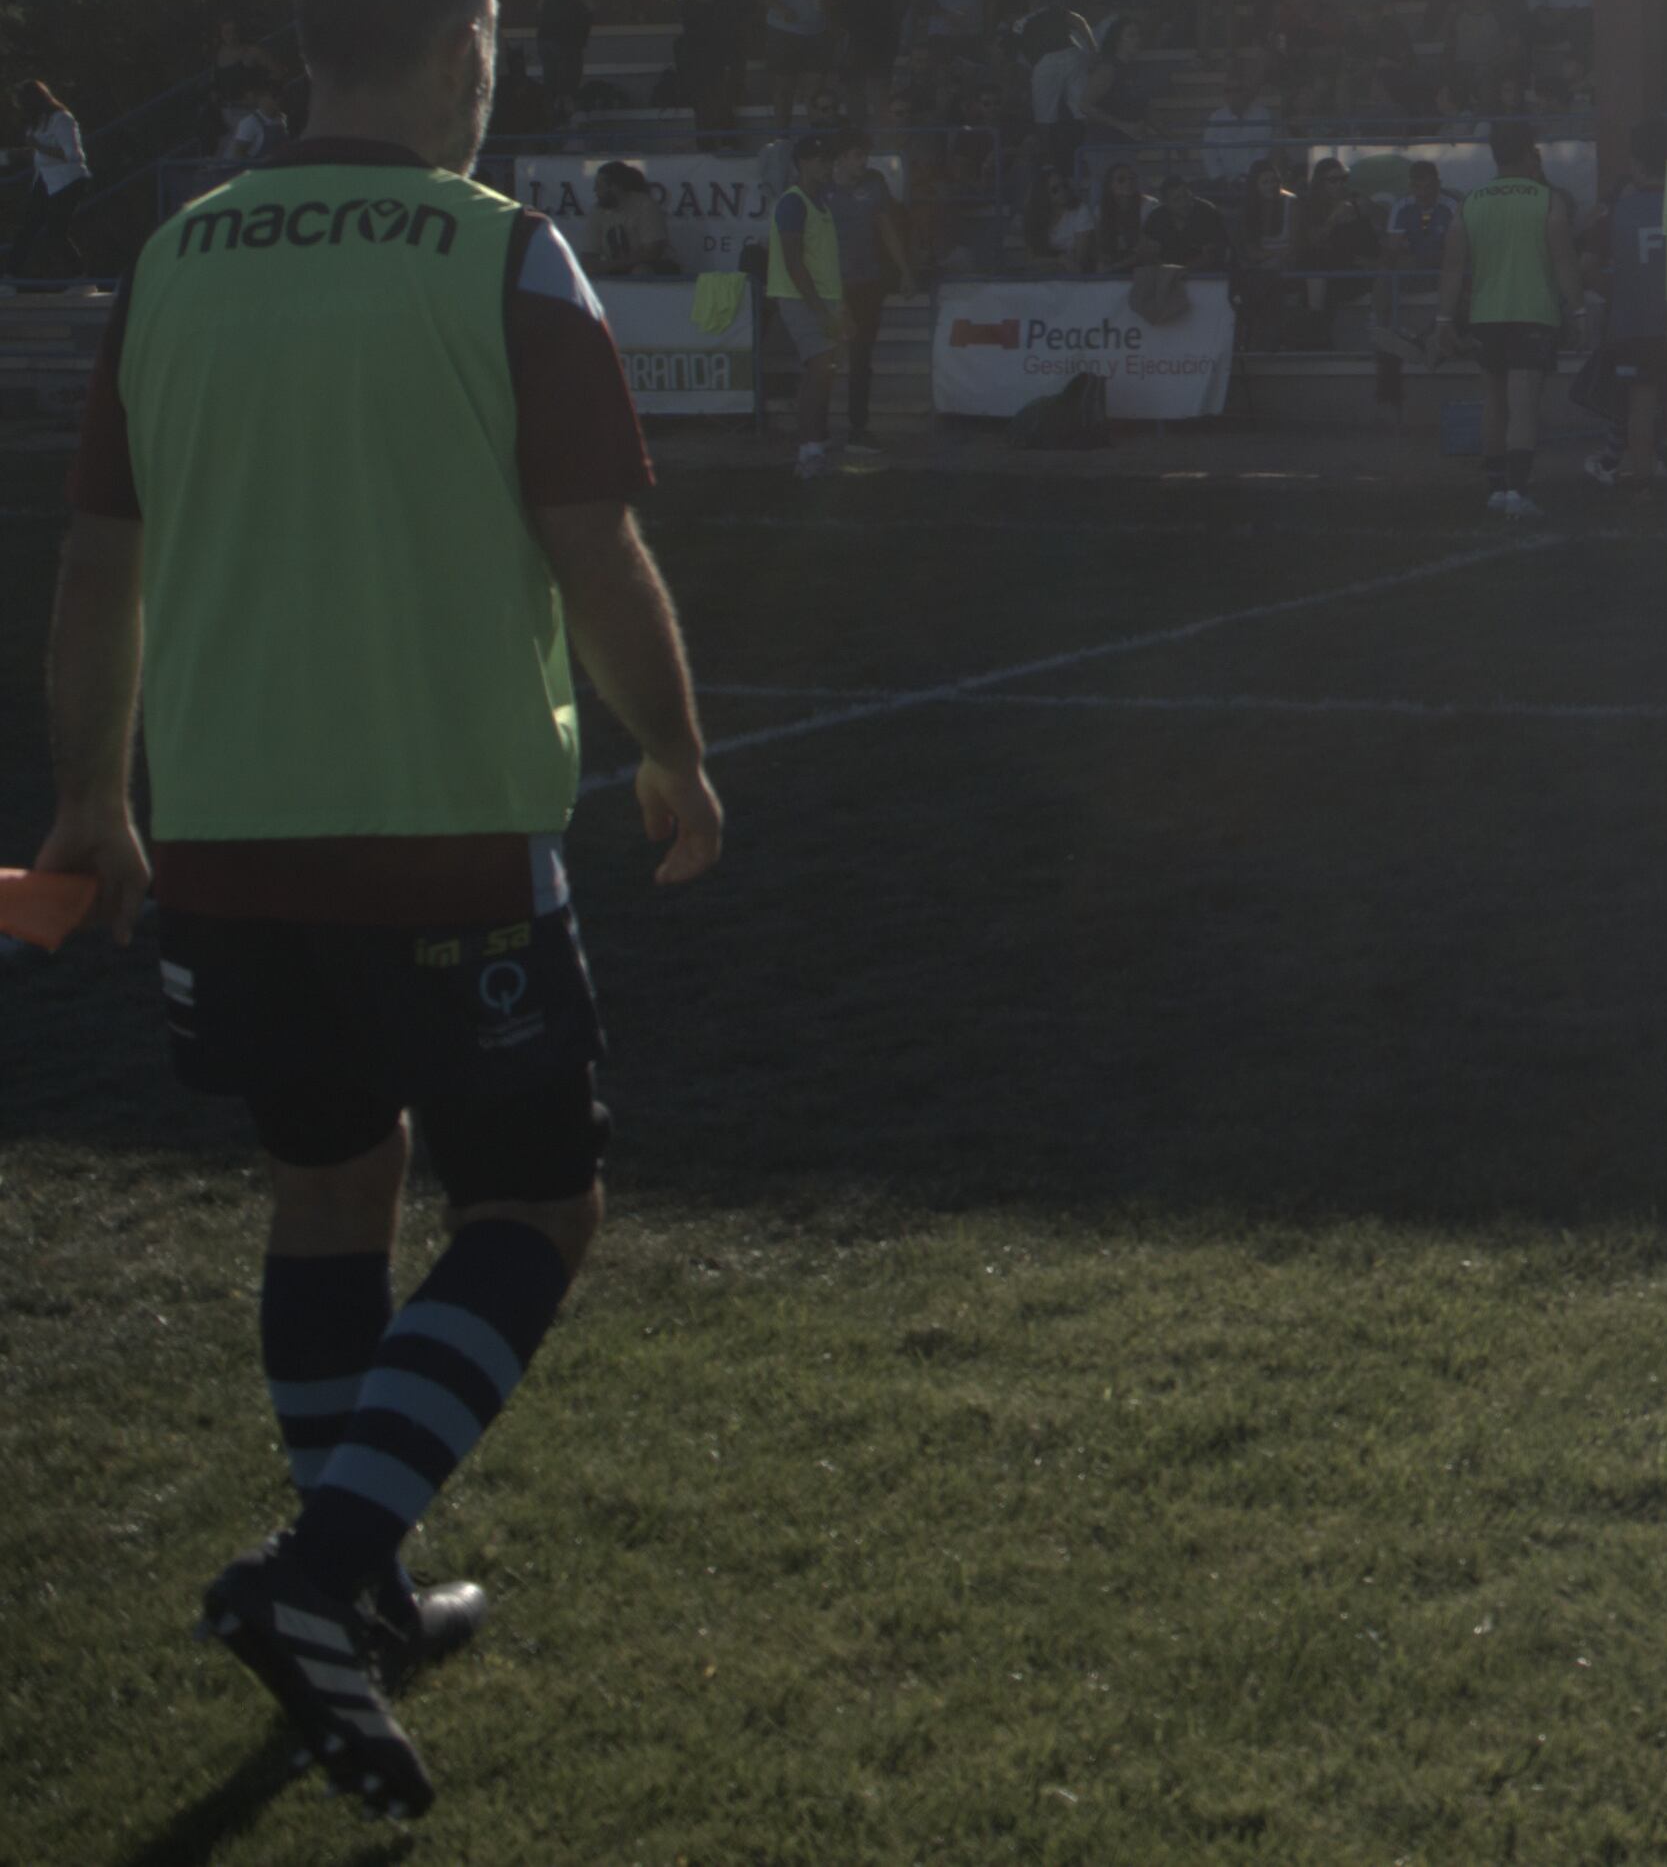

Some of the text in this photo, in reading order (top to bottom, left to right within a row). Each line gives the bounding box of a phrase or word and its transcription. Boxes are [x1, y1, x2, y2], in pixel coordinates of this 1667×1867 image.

[529, 181, 585, 217] LA
[1474, 184, 1538, 199] macron
[177, 198, 459, 260] macron
[1025, 318, 1143, 352] Peache
[1106, 359, 1119, 378] y
